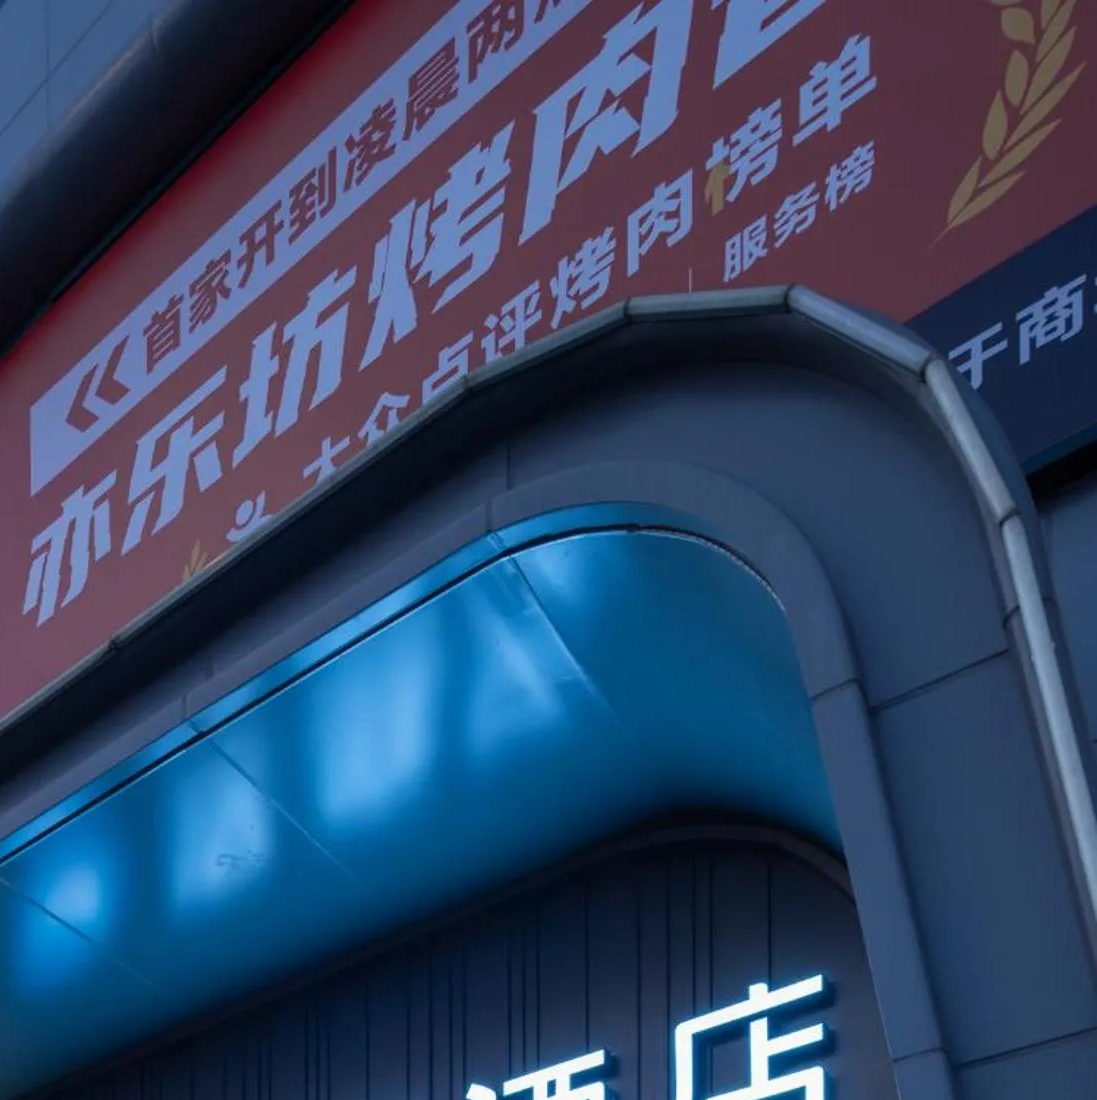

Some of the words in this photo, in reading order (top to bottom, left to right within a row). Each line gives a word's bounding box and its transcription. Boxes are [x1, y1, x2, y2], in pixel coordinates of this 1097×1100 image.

[724, 140, 876, 284] 服务榜
[948, 273, 1097, 390] 于商
